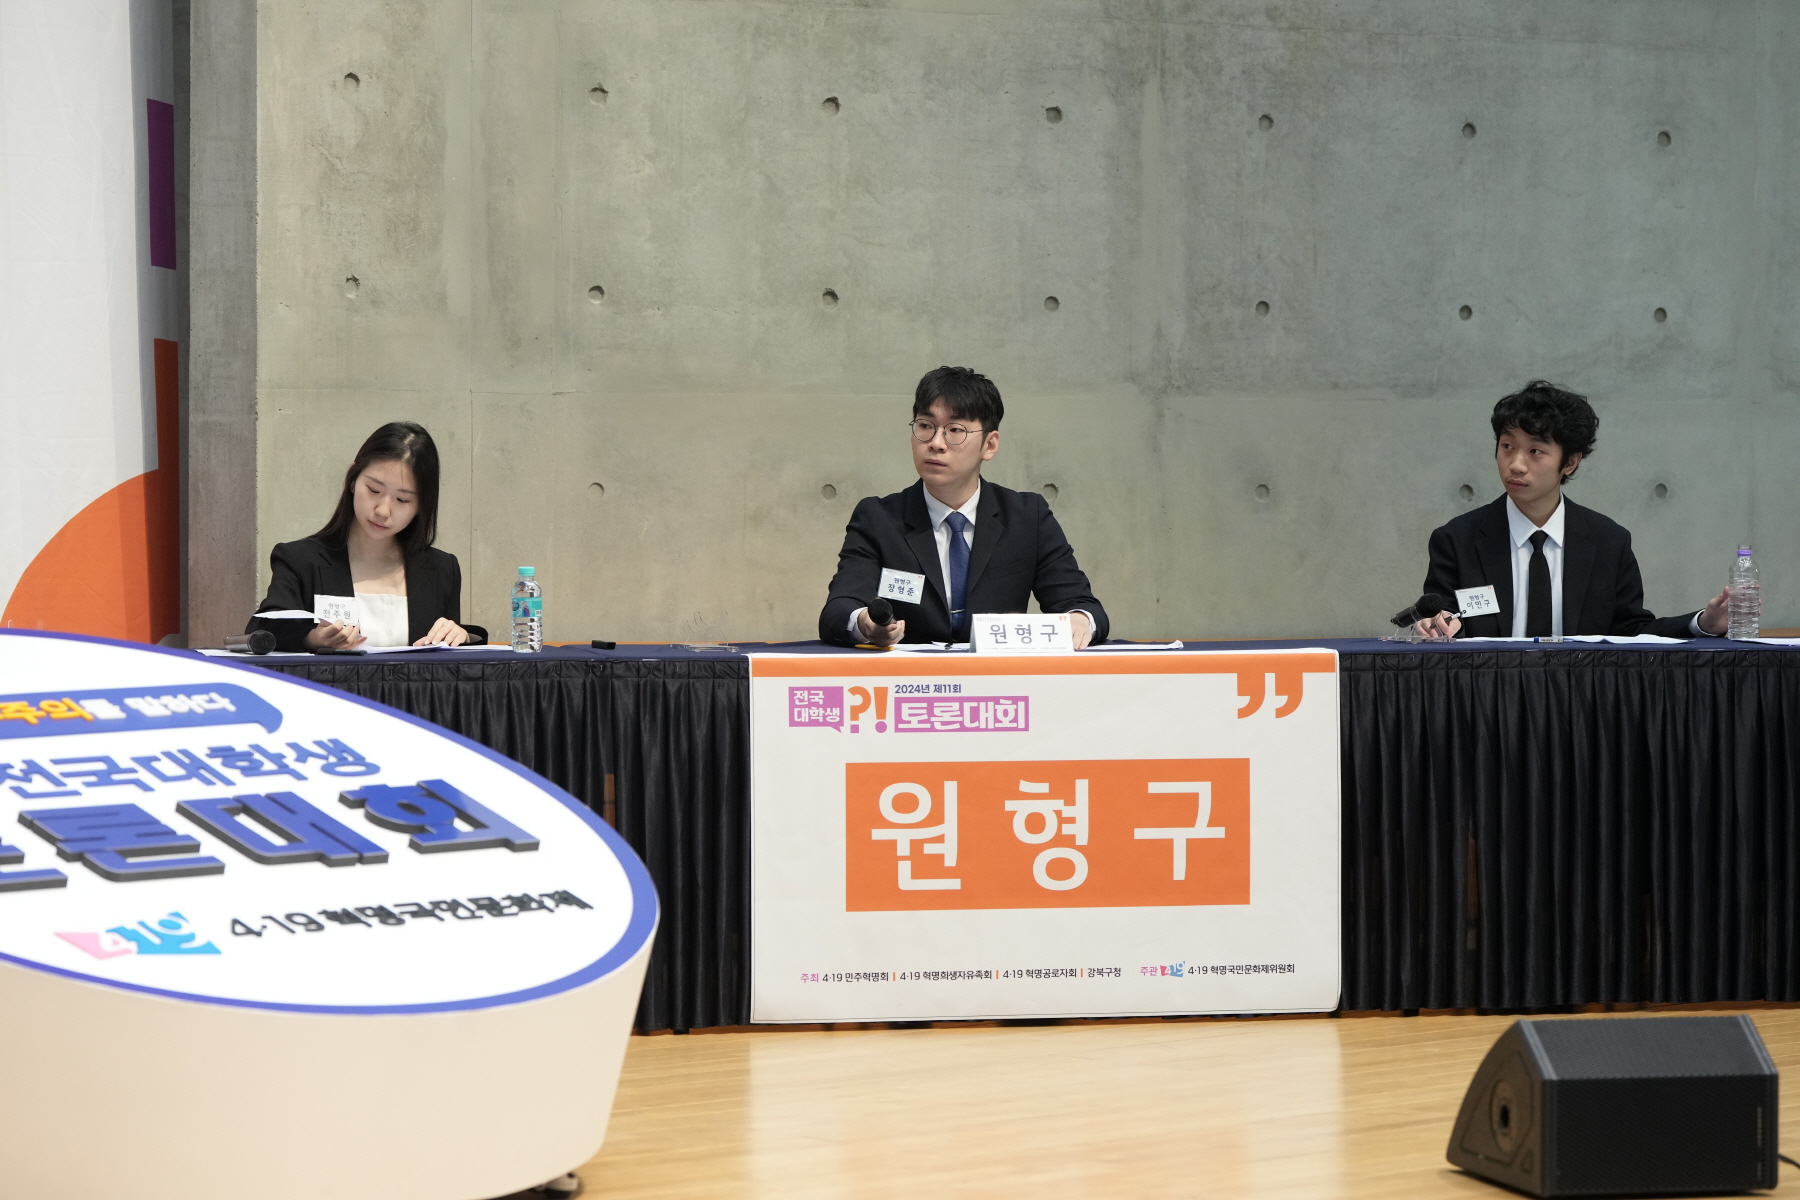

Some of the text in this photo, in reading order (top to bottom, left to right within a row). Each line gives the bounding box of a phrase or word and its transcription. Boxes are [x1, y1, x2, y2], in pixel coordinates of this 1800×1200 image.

[989, 623, 1059, 645] 원형구
[894, 683, 962, 694] 2024년 제11회
[793, 690, 825, 706] 전국
[793, 706, 841, 723] 대학생
[897, 698, 1025, 731] 토론대회
[0, 778, 540, 893] 론대회
[870, 778, 1226, 892] 원형구
[800, 972, 819, 983] 주최
[845, 972, 889, 983] 민주혁명회
[922, 970, 992, 981] 혁명희생자유족회
[1025, 968, 1077, 979] 혁명공로자회
[1087, 967, 1122, 978] 강북구청
[1139, 966, 1158, 977] 주관
[1210, 963, 1295, 975] 혁명국민문화제위원회
